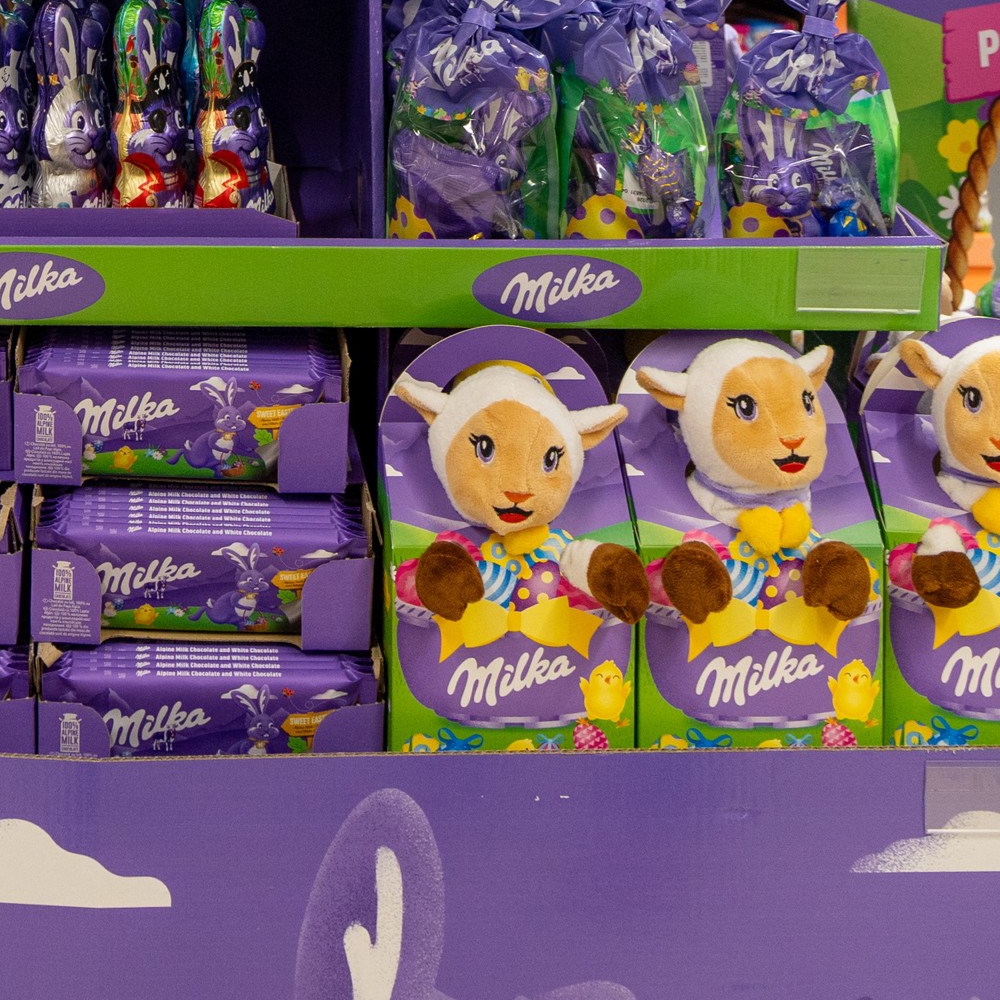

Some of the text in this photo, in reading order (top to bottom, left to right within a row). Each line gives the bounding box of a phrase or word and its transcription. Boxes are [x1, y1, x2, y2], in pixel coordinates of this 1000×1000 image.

[501, 262, 620, 315] Milka
[37, 427, 53, 435] MILK
[74, 392, 180, 436] Milka
[55, 584, 72, 592] MILK
[97, 556, 202, 596] Milka
[447, 647, 576, 707] Milka
[695, 645, 825, 708] Milka
[941, 646, 1000, 698] M
[103, 701, 211, 748] Milka
